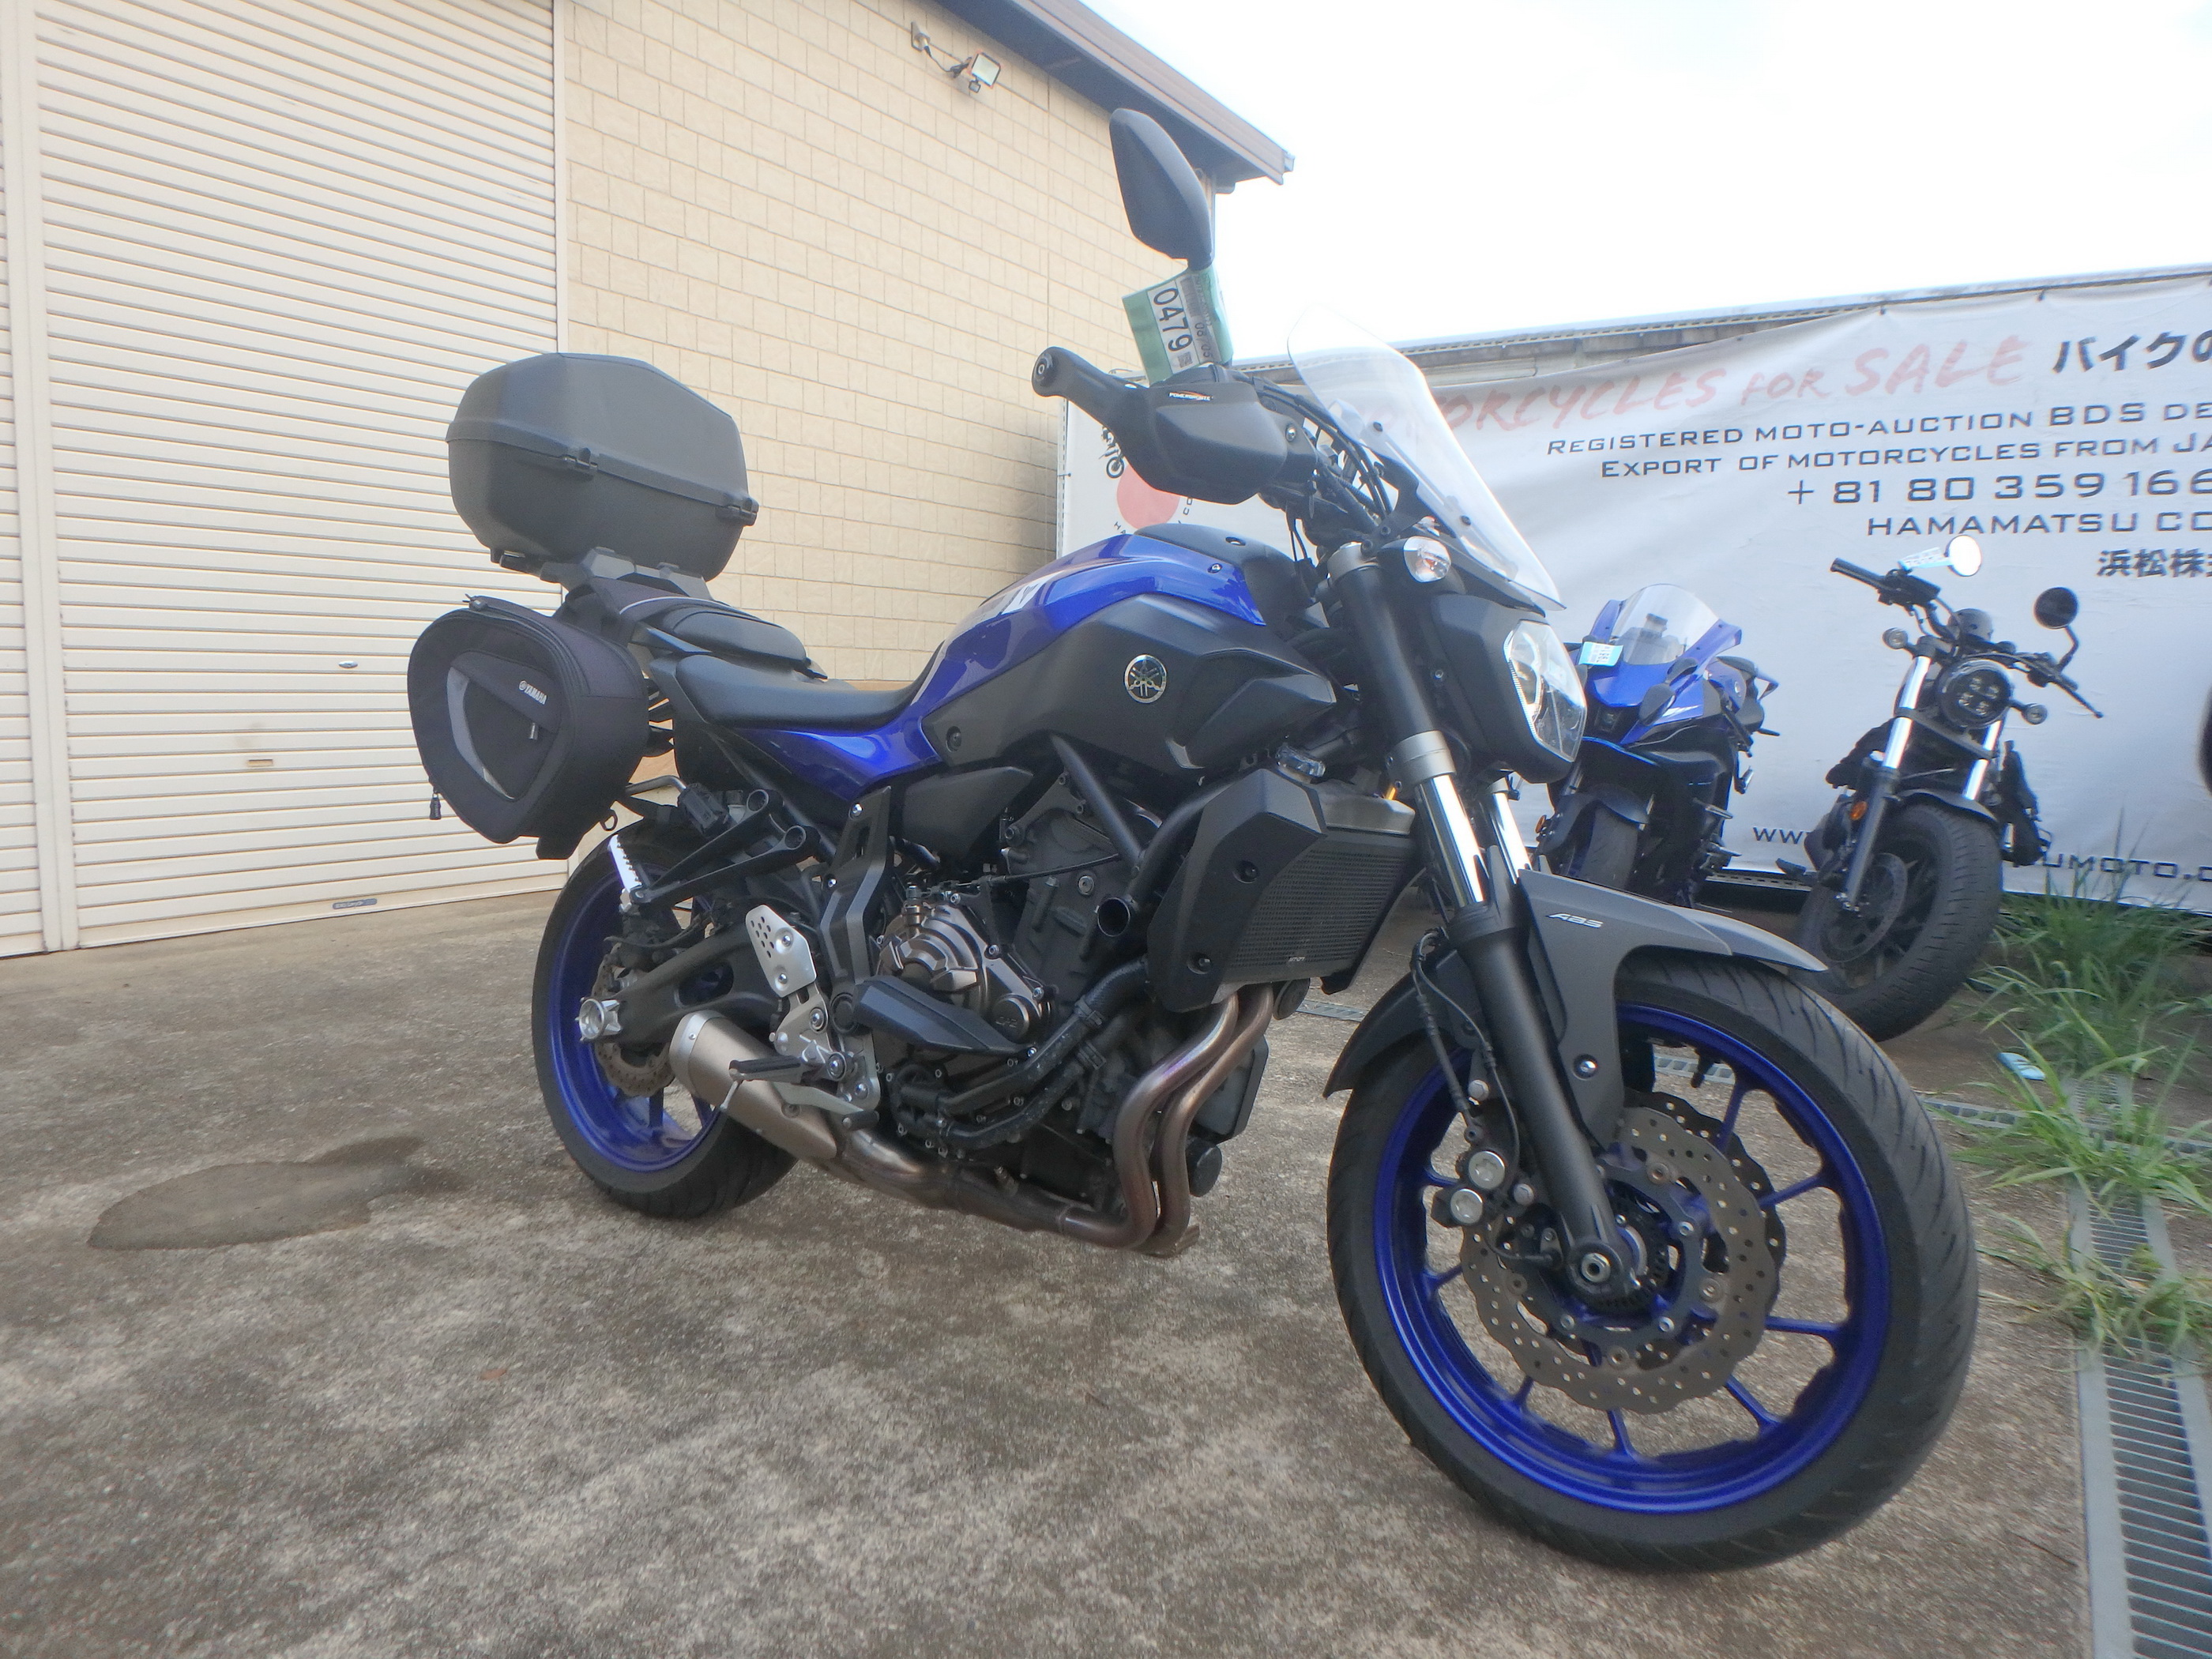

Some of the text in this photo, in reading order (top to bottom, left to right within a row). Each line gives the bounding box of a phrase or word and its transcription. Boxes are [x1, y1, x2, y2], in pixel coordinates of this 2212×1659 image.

[1153, 287, 1194, 352] 0479
[1846, 335, 2029, 394] SALE
[1547, 428, 1743, 456] REGISTERED
[1755, 410, 2033, 442] MOTO-AUCTION
[2049, 402, 2146, 427] BDS
[1601, 456, 1721, 478] EXPORT
[1739, 455, 1779, 471] OF
[1788, 443, 2040, 468] MOTORCYCLES
[2055, 438, 2159, 458] FROM
[1834, 480, 1880, 504] 81
[1906, 476, 1975, 502] 80
[1994, 473, 2105, 499] 359
[1867, 513, 2138, 536] HAMAMATSU
[2096, 548, 2212, 578] 浜松株
[525, 683, 548, 705] YAMAHA
[1548, 912, 1604, 928] ABS
